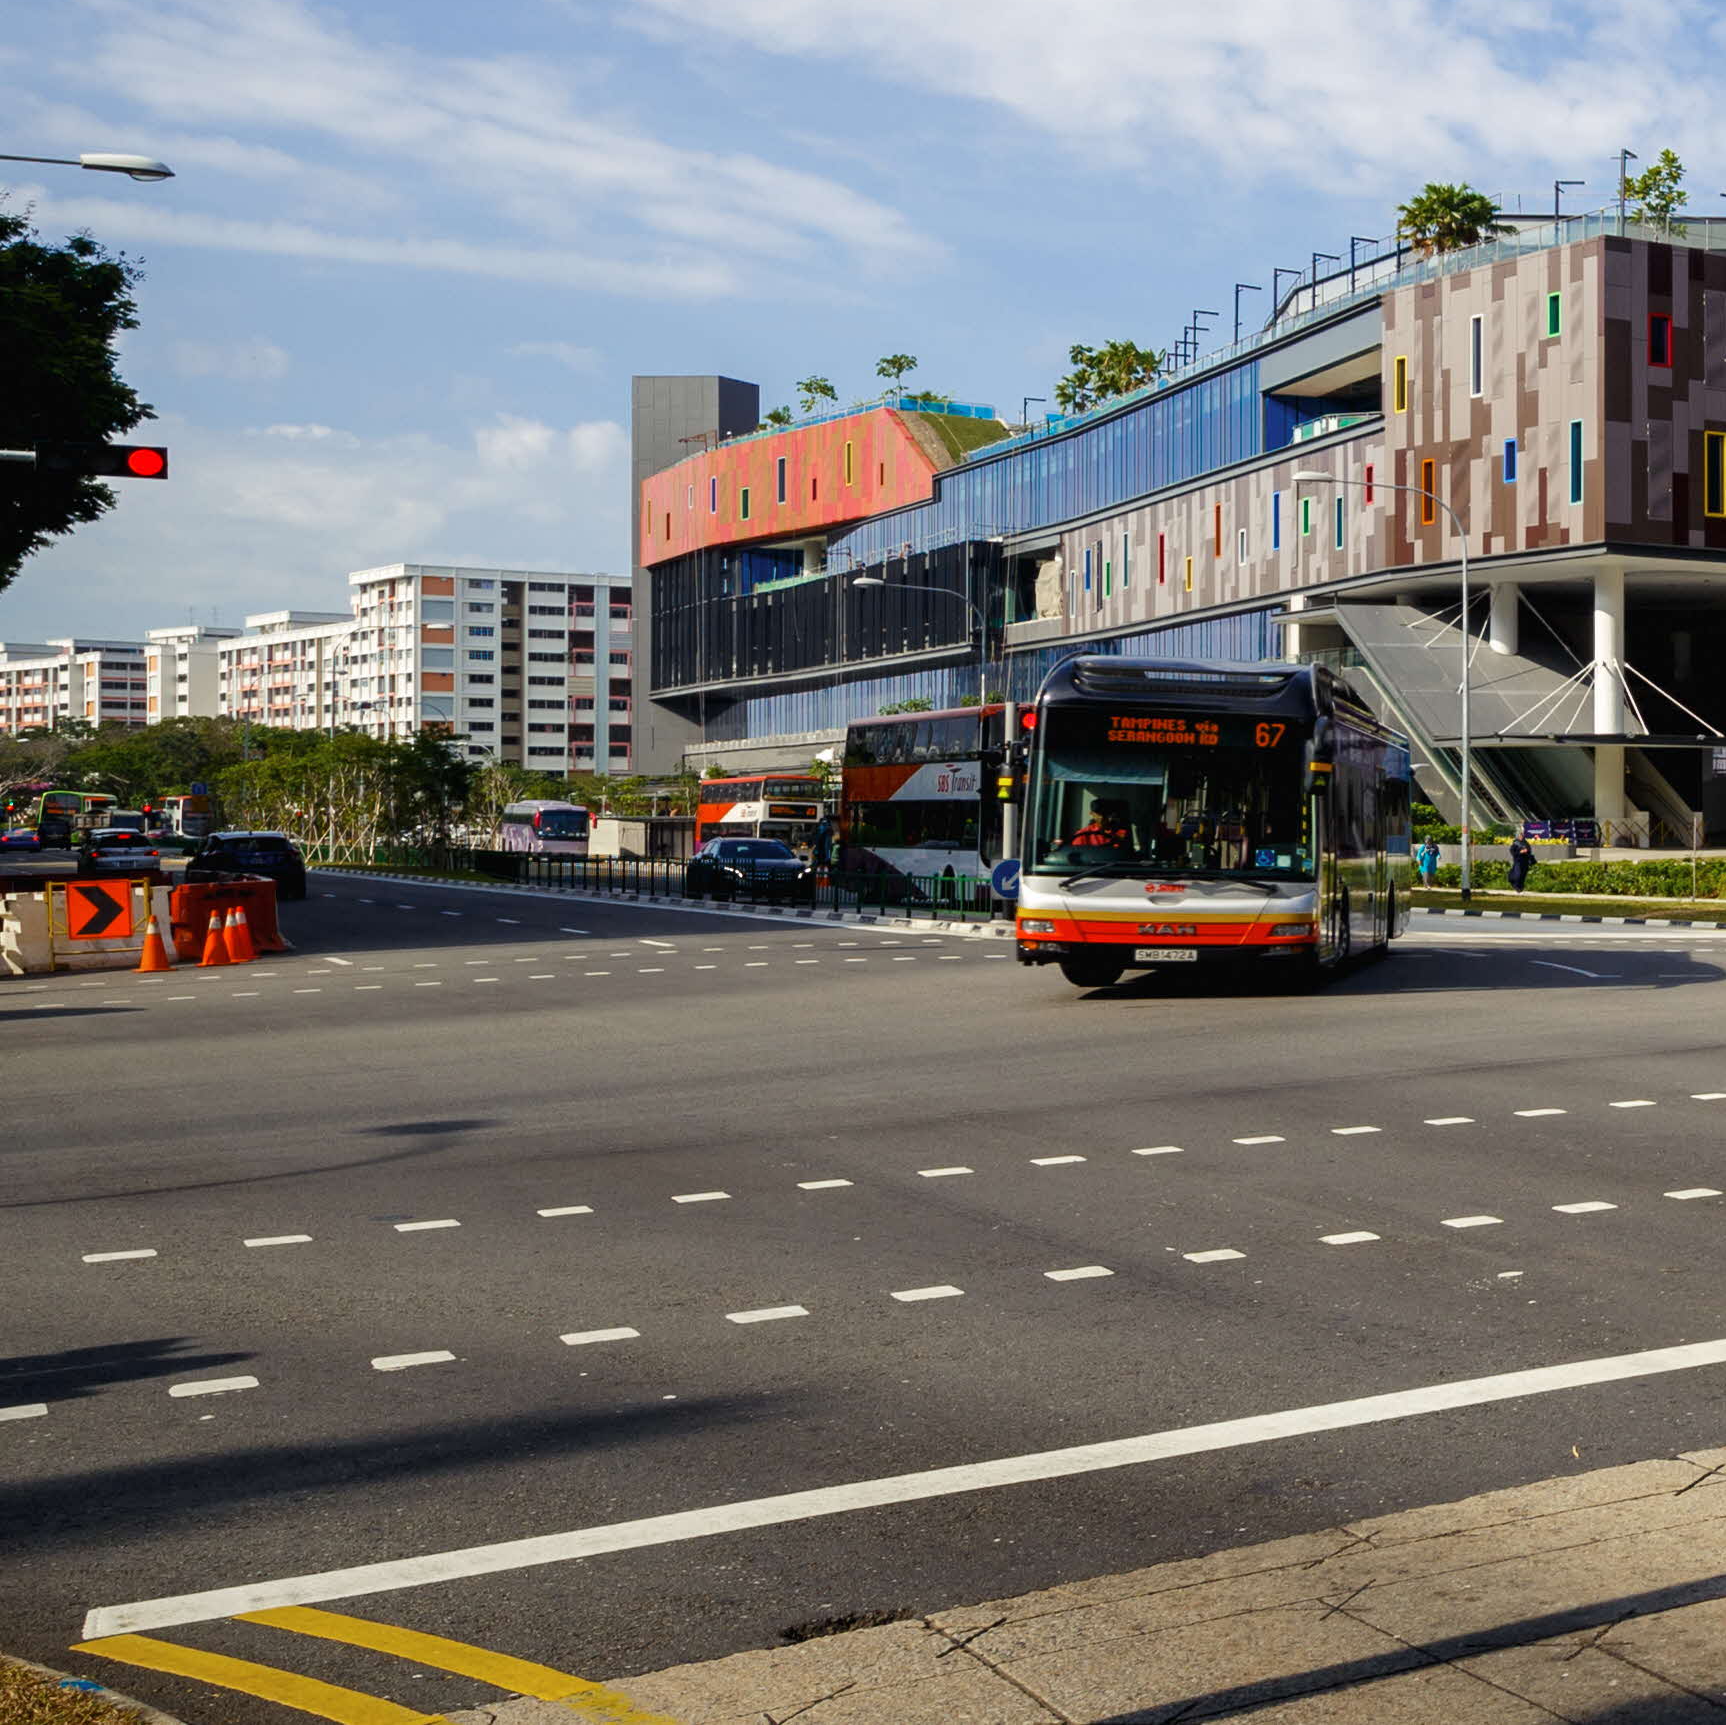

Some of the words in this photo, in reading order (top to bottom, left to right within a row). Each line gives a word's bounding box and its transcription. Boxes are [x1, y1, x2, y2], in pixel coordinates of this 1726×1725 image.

[1110, 716, 1186, 731] TAMPINES
[1195, 722, 1219, 733] via
[1108, 729, 1195, 744] SERANGOON
[1199, 733, 1219, 745] RD
[1255, 722, 1286, 747] 67
[1137, 924, 1197, 936] MAN
[1137, 950, 1195, 960] SMB1472A
